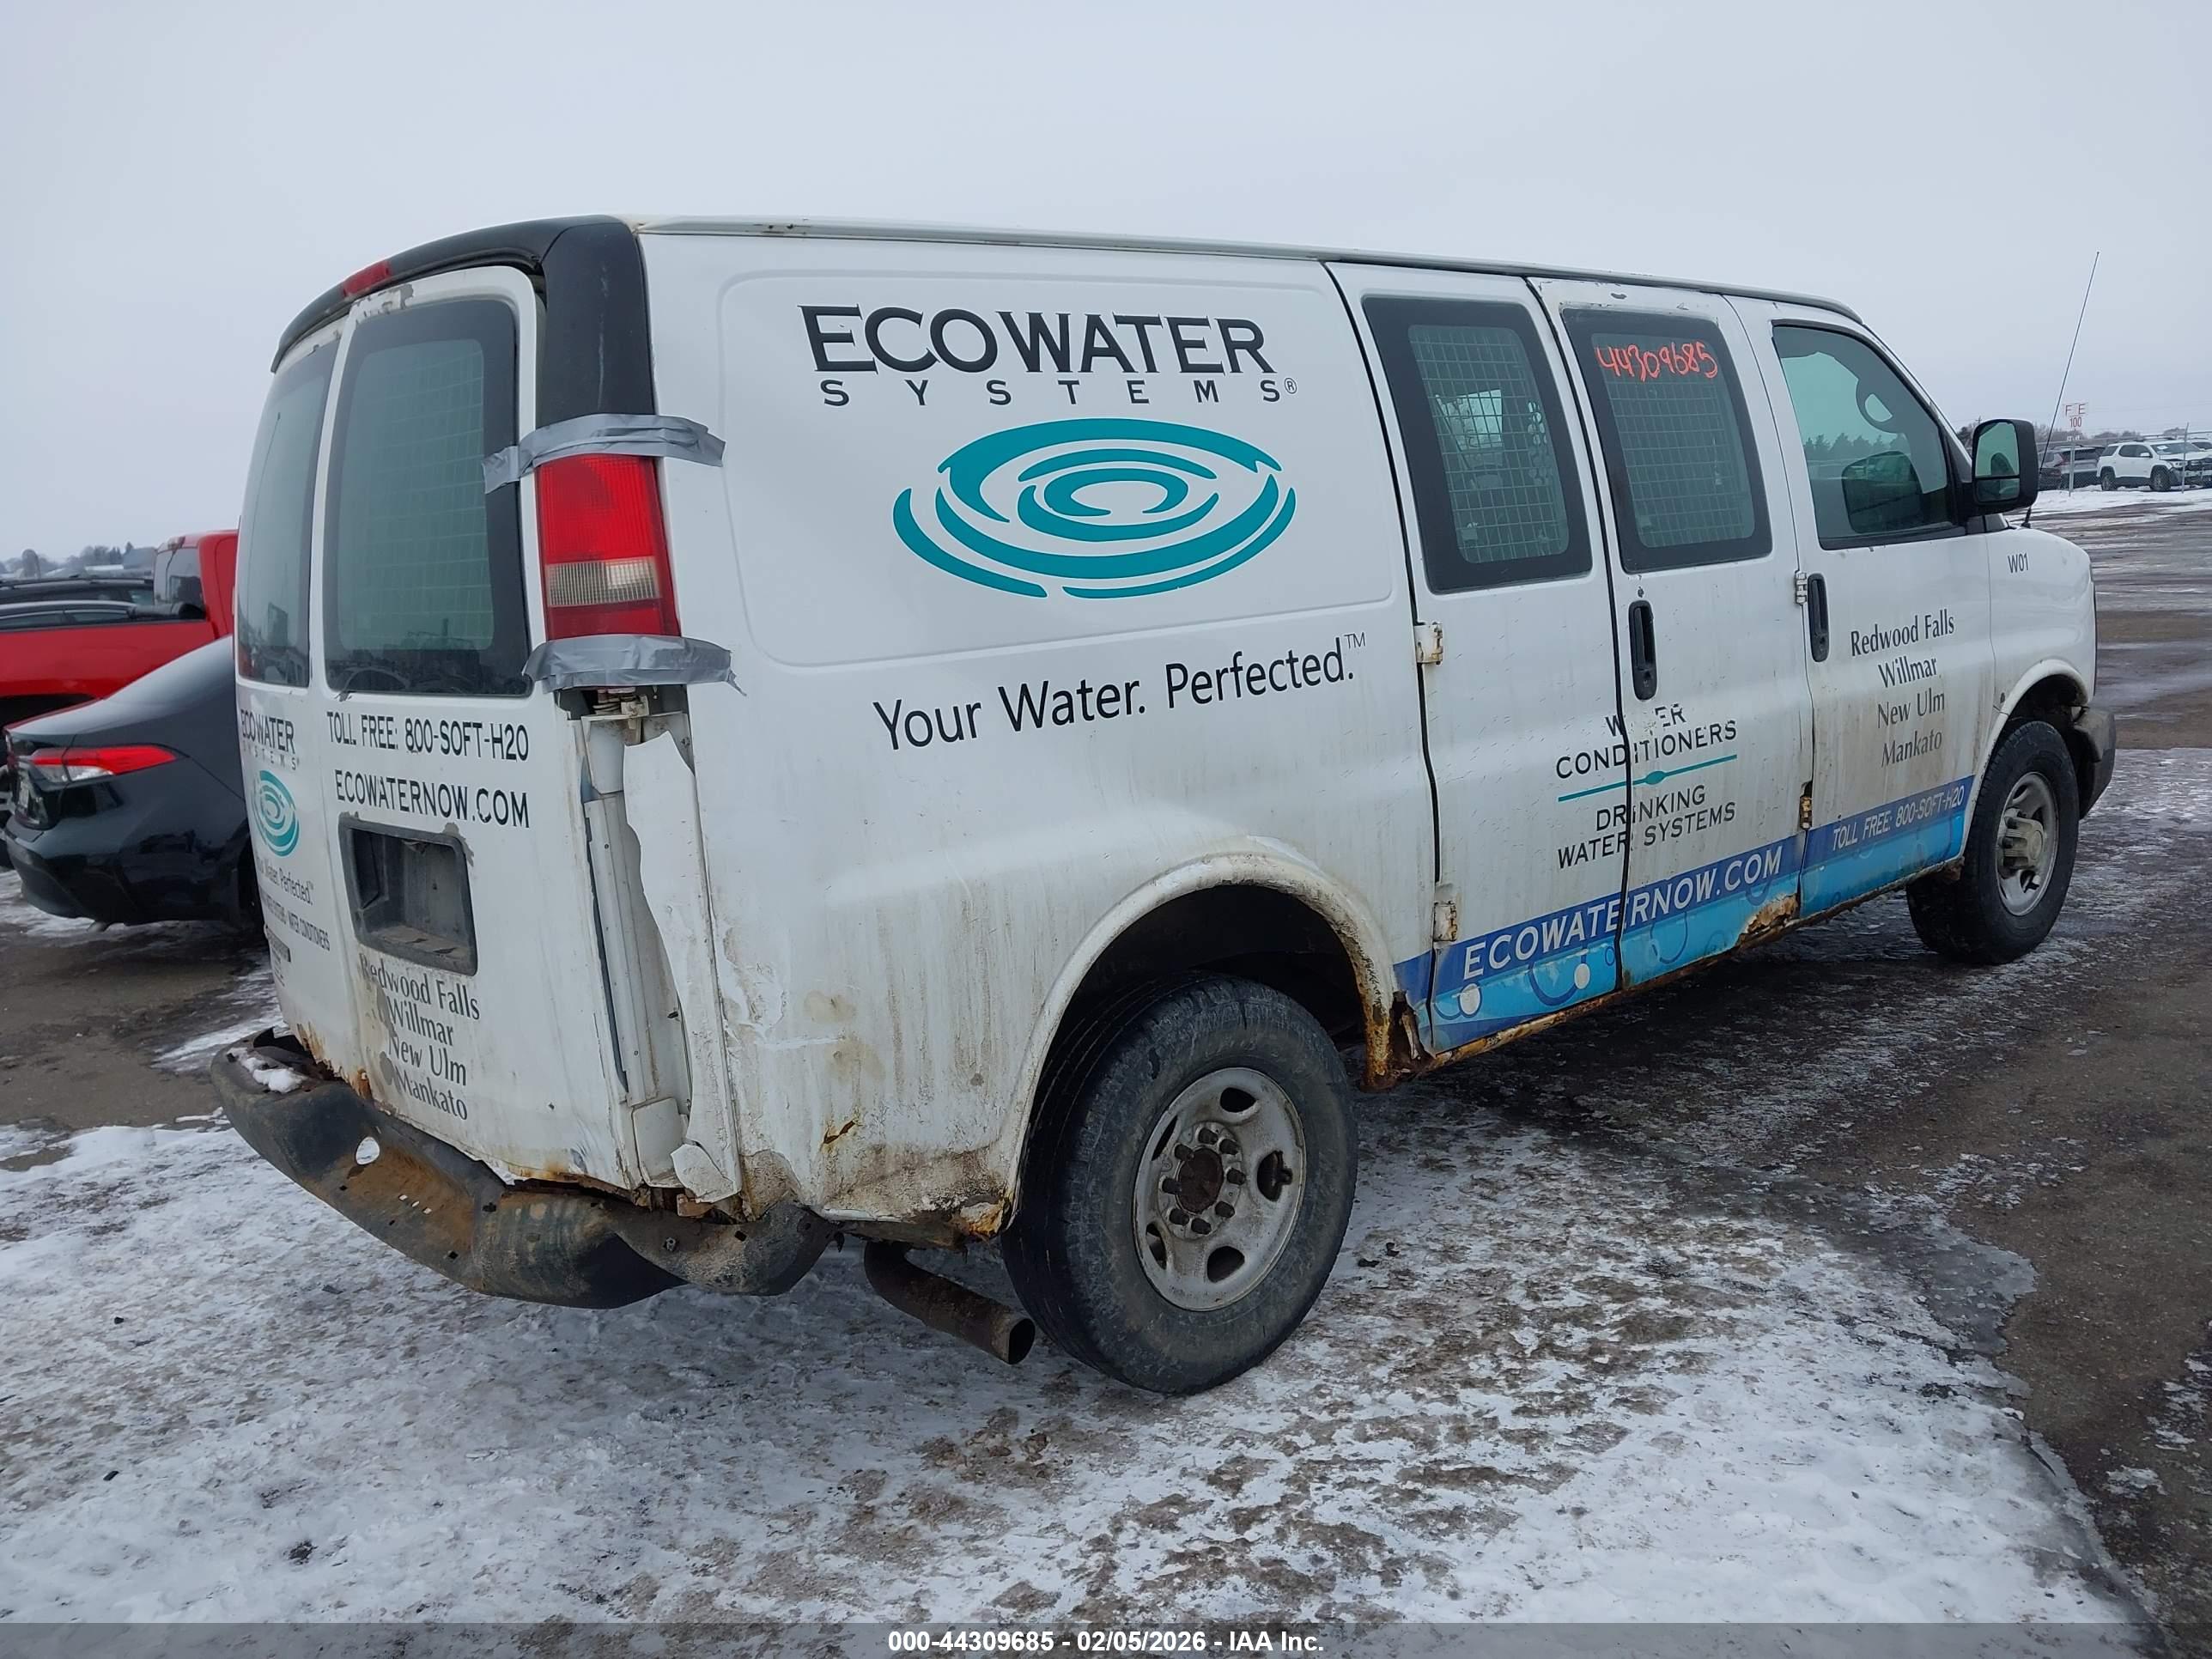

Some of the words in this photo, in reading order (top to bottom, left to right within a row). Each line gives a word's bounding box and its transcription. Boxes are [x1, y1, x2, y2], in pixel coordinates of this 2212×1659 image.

[798, 304, 1279, 374] ECOWATER
[1595, 341, 1718, 382] 44309685
[2007, 553, 2029, 574] W01
[1850, 615, 1919, 656] Redwood
[1923, 609, 1955, 640] Falls
[1877, 655, 1938, 688] Willmar
[240, 708, 295, 755] ECOWATER
[326, 711, 357, 745] TOLL
[361, 714, 398, 750] FREE:
[873, 699, 982, 750] Your
[999, 680, 1146, 732] Water.
[1606, 702, 1686, 737] WER
[1877, 701, 1911, 729] New
[1916, 687, 1946, 717] Ulm
[1555, 720, 1737, 780] CONDITIONERS
[1881, 728, 1943, 768] Mankato
[334, 769, 530, 829] ECOWATERNOW.COM
[1557, 831, 1633, 869] WATER
[1643, 801, 1736, 847] SYSTEMS
[1832, 822, 1858, 851] TOLL
[1862, 810, 1893, 841] FREE:
[1462, 846, 1784, 981] ECOWATERNOW.COM
[359, 952, 431, 1006] Redwood
[435, 979, 480, 1020] Falls
[387, 996, 454, 1047] Willmar
[388, 1036, 422, 1068] New
[429, 1045, 467, 1086] Ulm
[394, 1066, 468, 1121] Mankato
